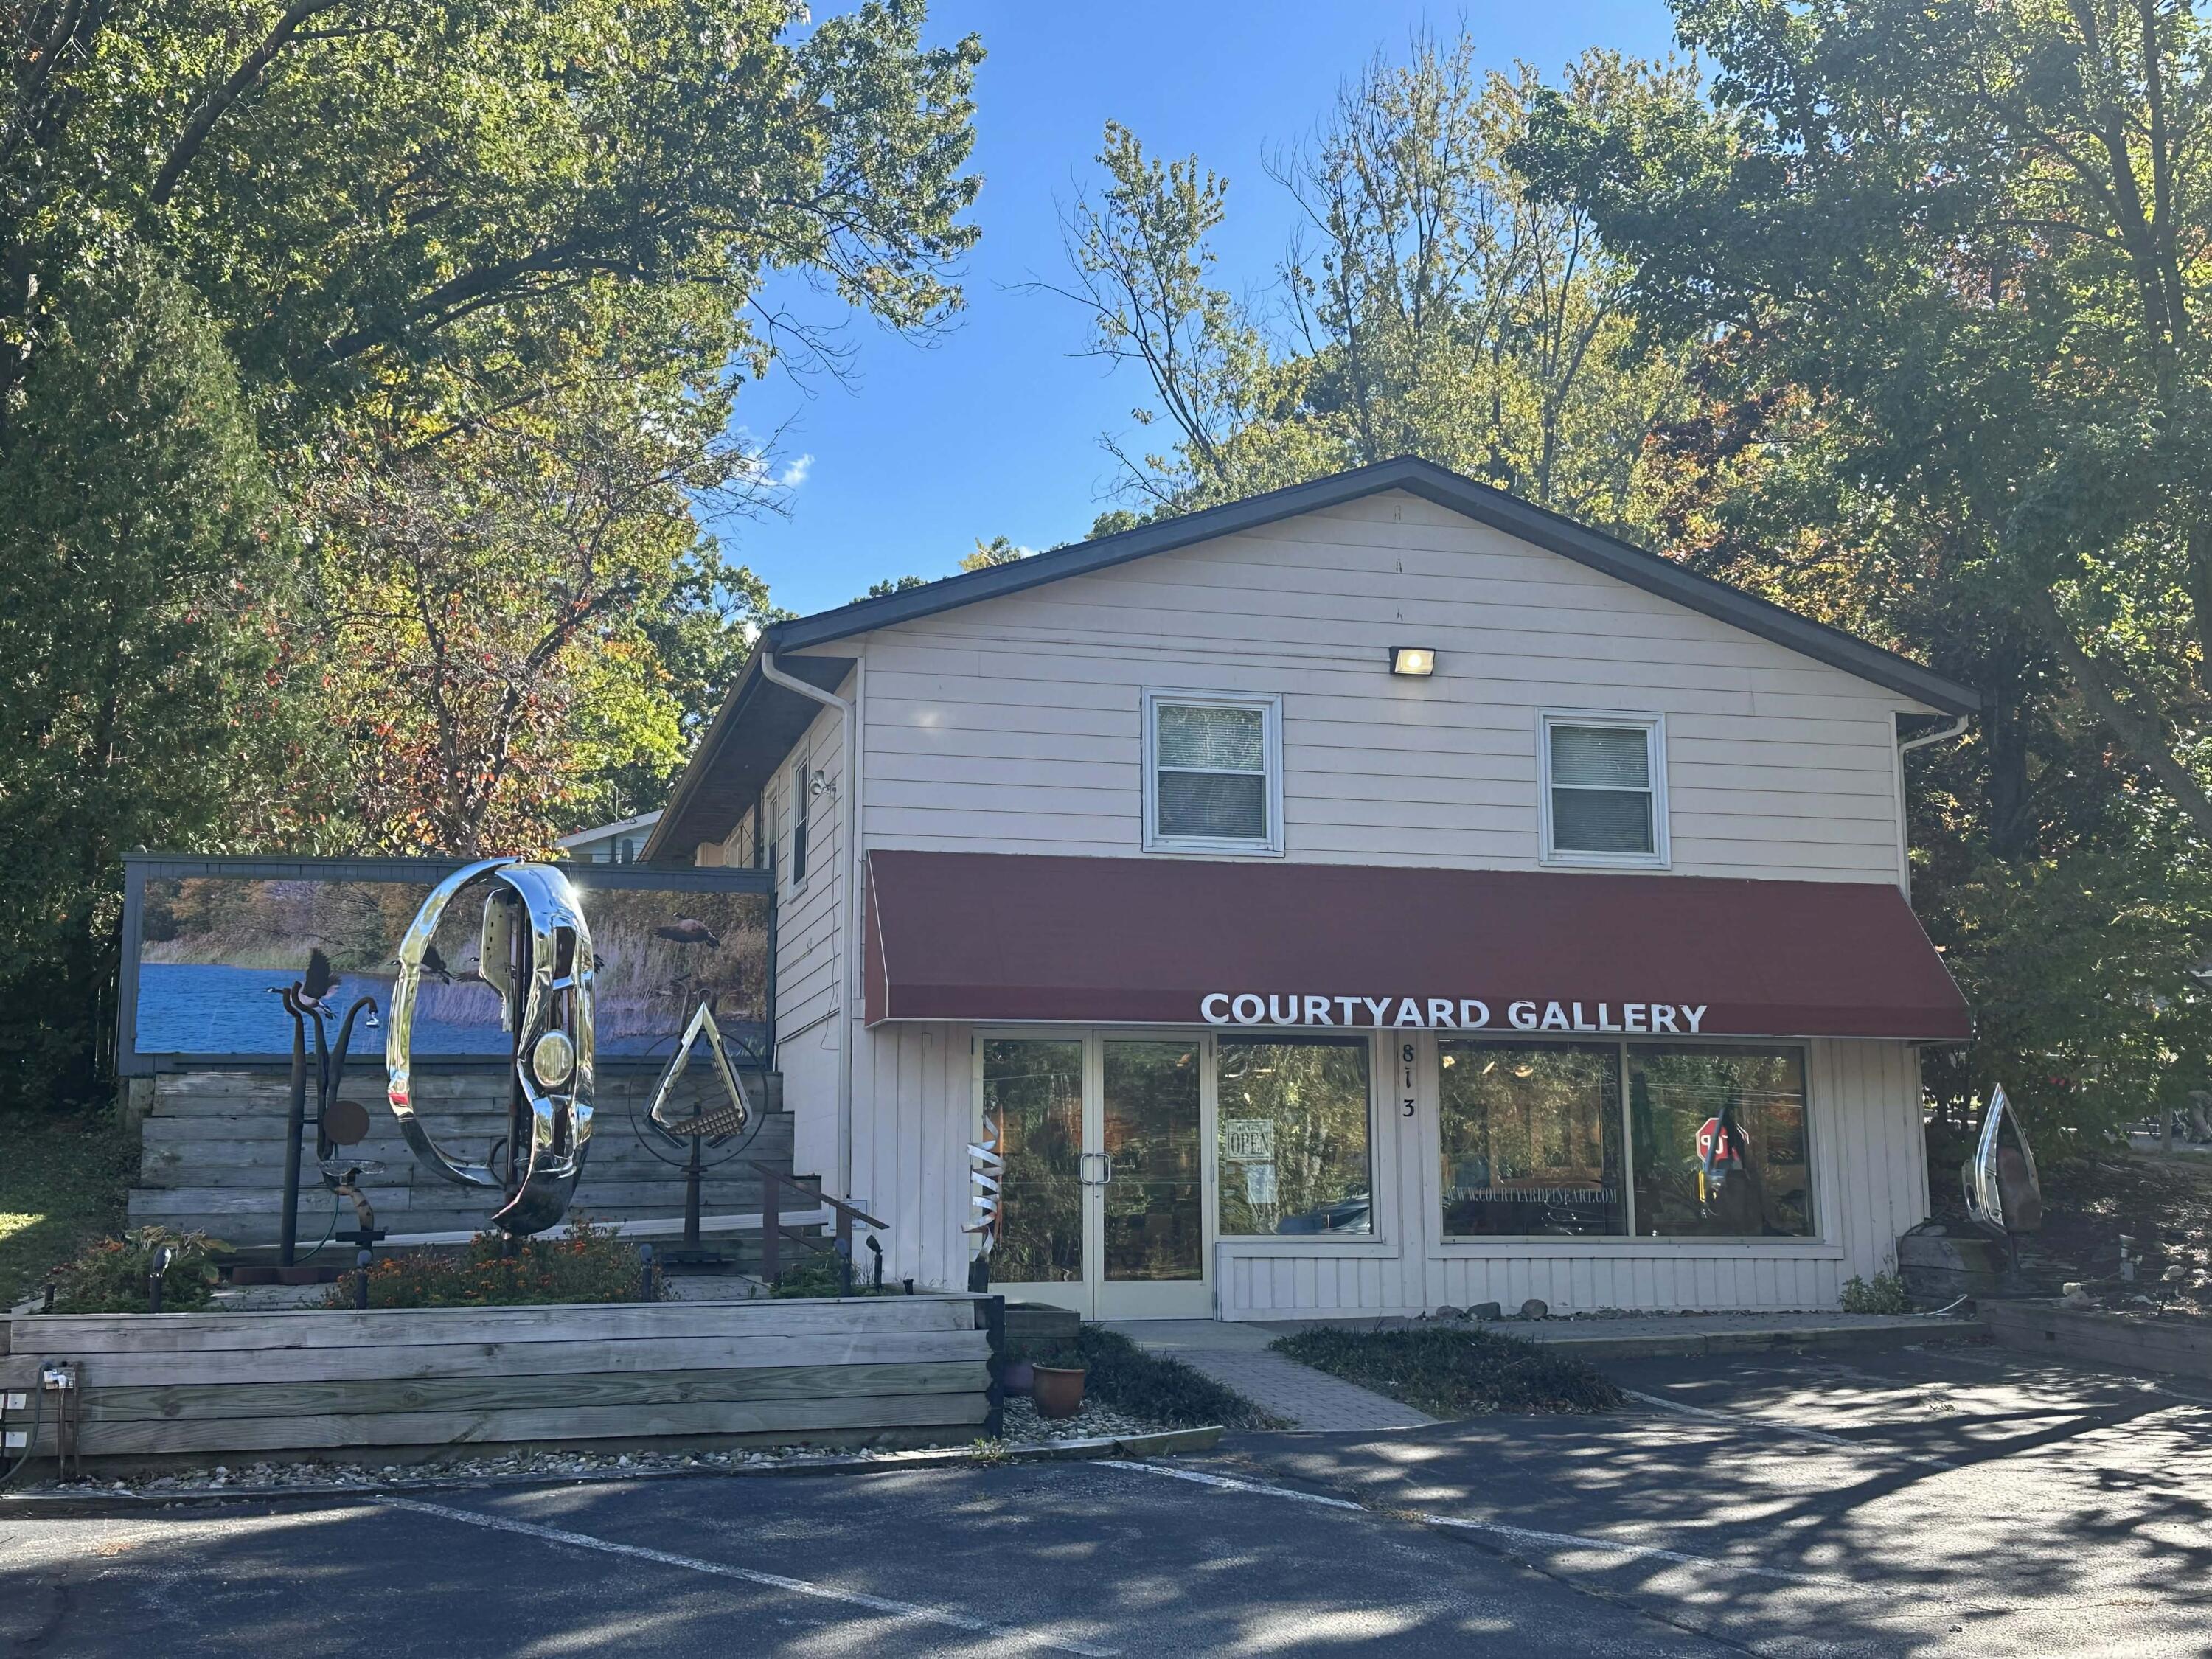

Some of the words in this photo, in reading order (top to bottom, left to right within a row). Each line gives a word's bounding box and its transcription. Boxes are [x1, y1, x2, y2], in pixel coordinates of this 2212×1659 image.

[1200, 992, 1490, 1029] COURTYARD
[1507, 1001, 1708, 1033] GALLERY
[1402, 1044, 1415, 1117] 813
[1230, 1132, 1270, 1155] OPEN
[1446, 1186, 1618, 1203] WWW.COURTYARDFINEART.COM
